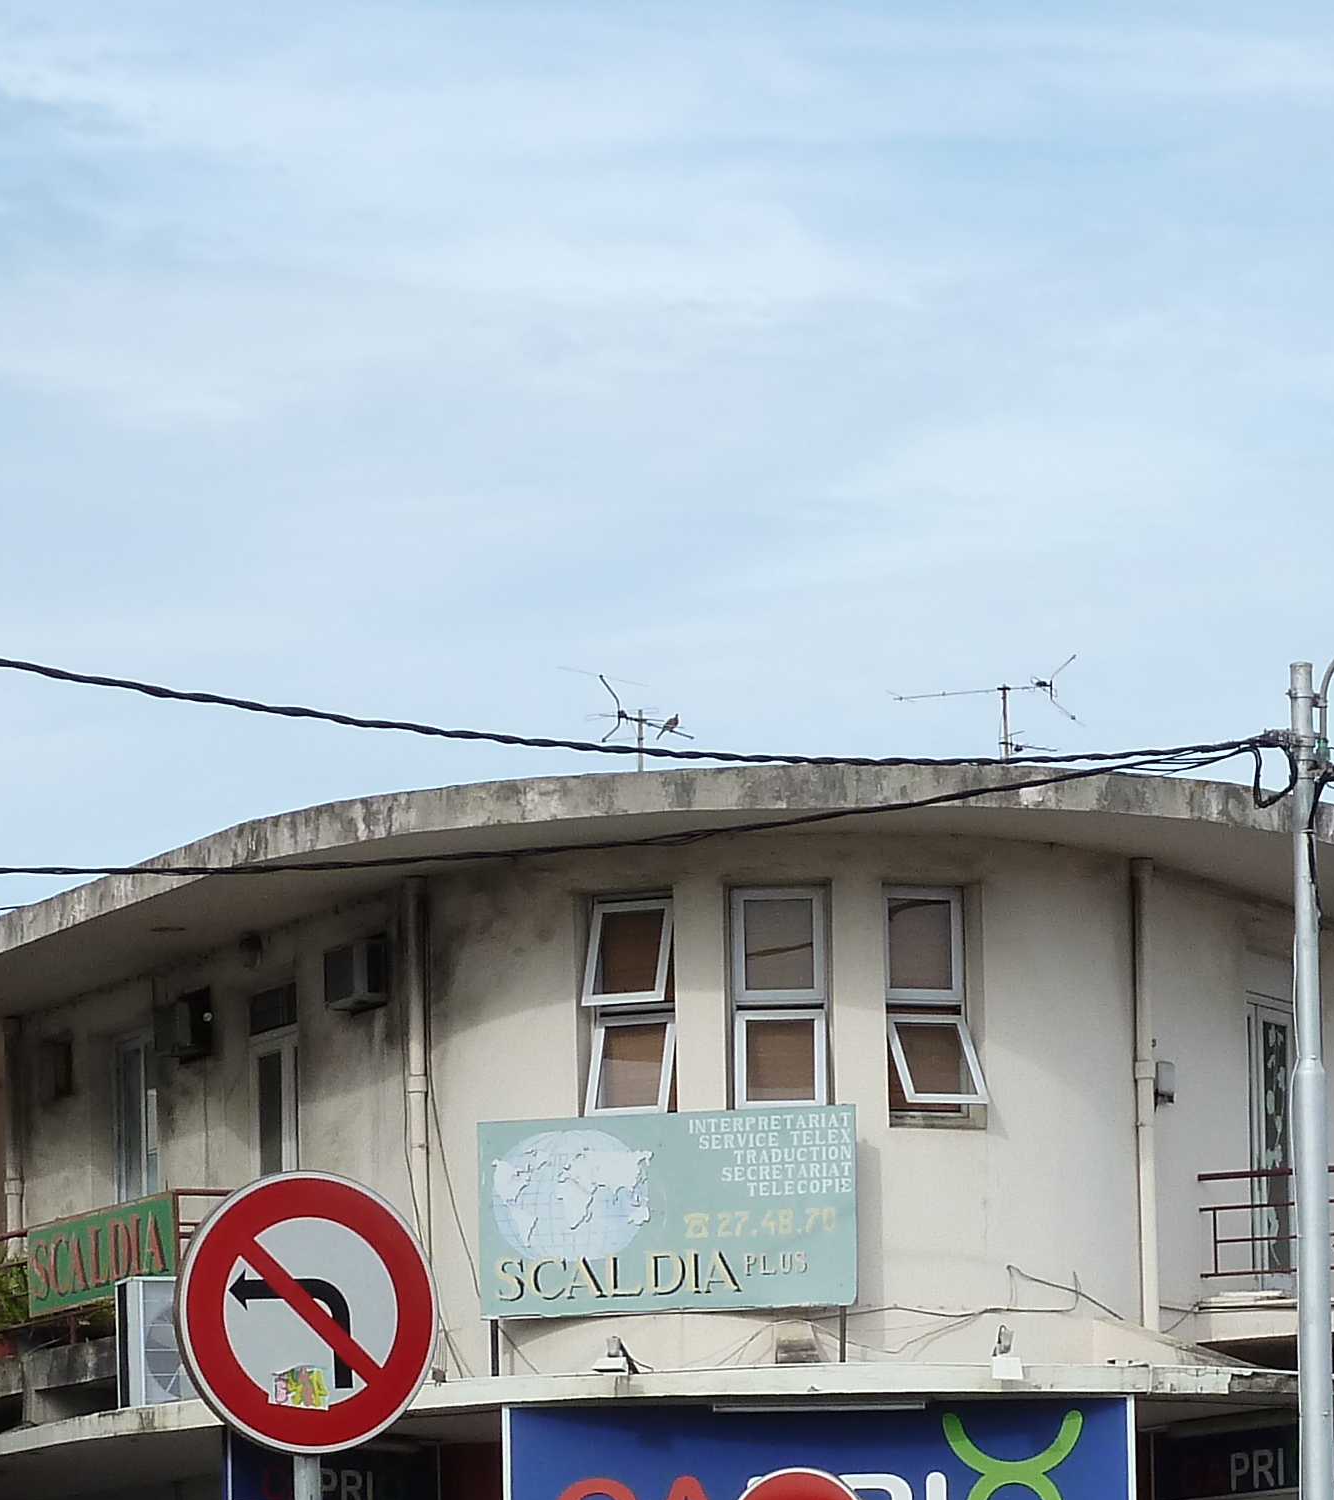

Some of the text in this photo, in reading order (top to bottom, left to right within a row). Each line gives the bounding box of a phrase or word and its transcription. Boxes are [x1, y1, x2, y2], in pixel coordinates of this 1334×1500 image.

[688, 1112, 851, 1134] INTERPRETARIAT
[699, 1129, 851, 1150] SERVICE TELEX
[734, 1145, 852, 1164] TRADUCTION
[721, 1162, 852, 1182] SECRETARIAT
[746, 1178, 852, 1197] TELECOPIE
[29, 1210, 169, 1301] SCALDIA
[494, 1250, 809, 1302] SCALDIA PLUS
